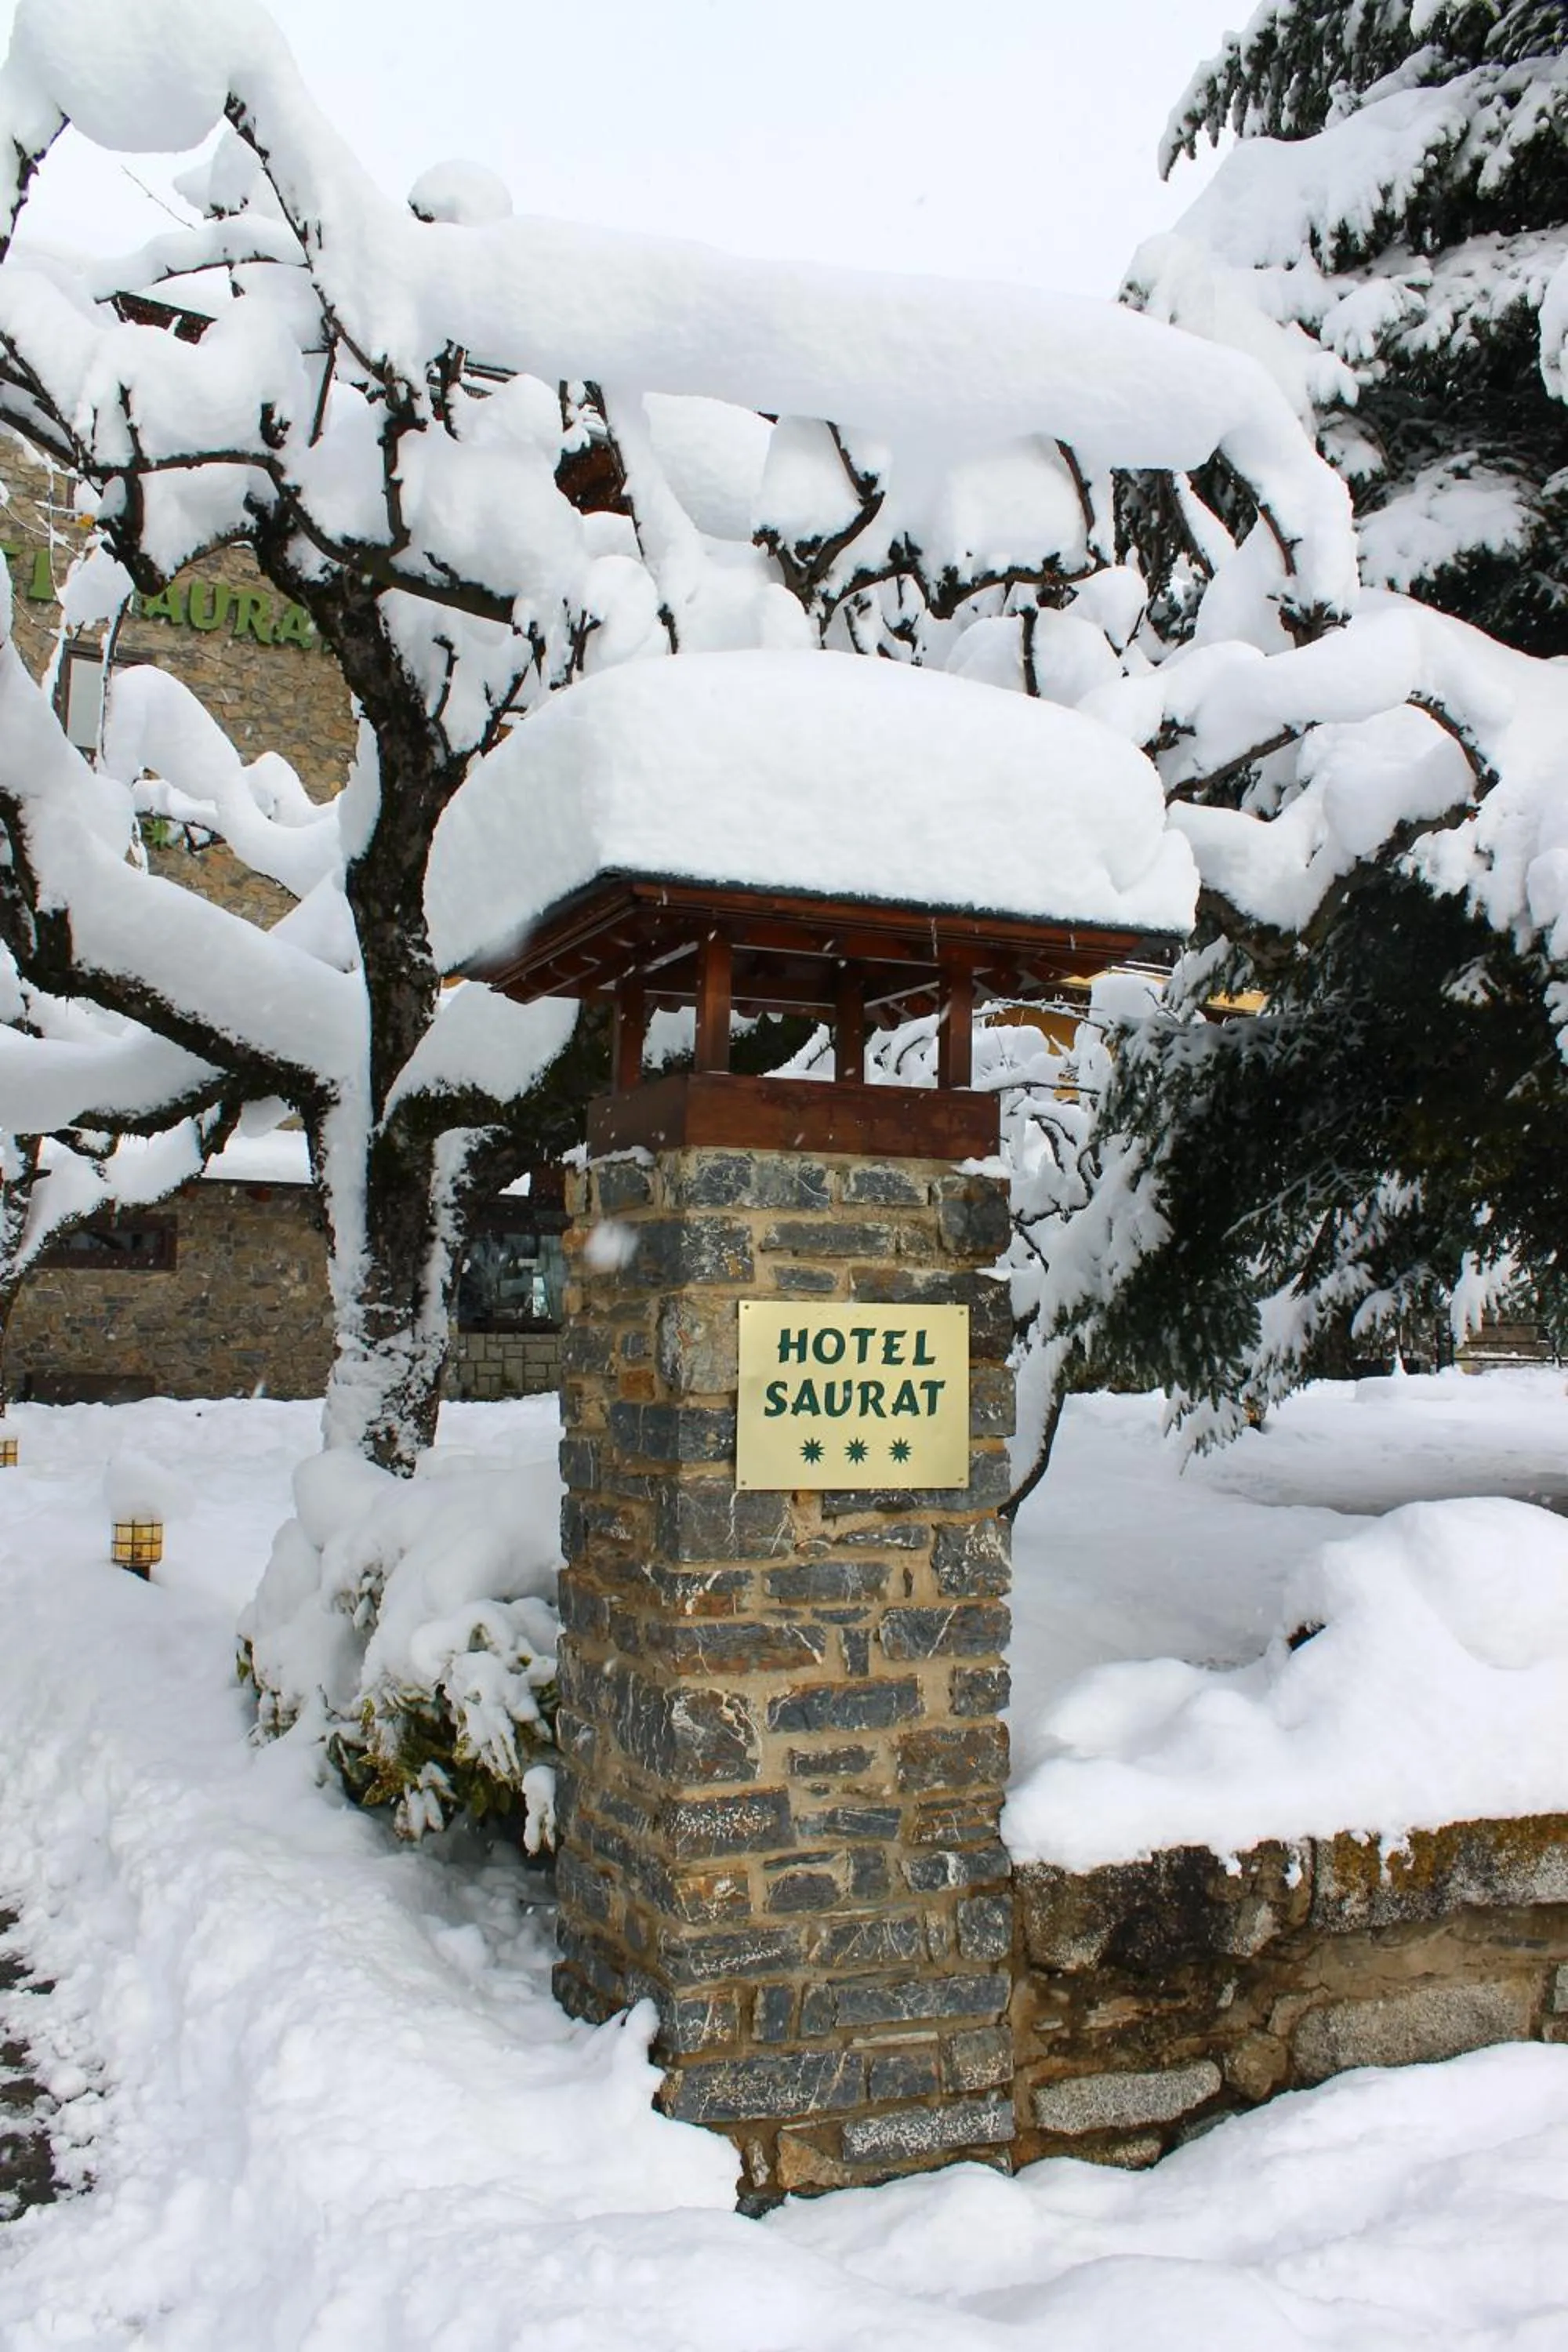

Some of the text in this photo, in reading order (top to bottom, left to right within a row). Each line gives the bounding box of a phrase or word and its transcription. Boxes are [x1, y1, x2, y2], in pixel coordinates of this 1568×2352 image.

[133, 581, 332, 652] AURA
[778, 1327, 936, 1366] HOTEL
[764, 1378, 946, 1418] SAURAT
